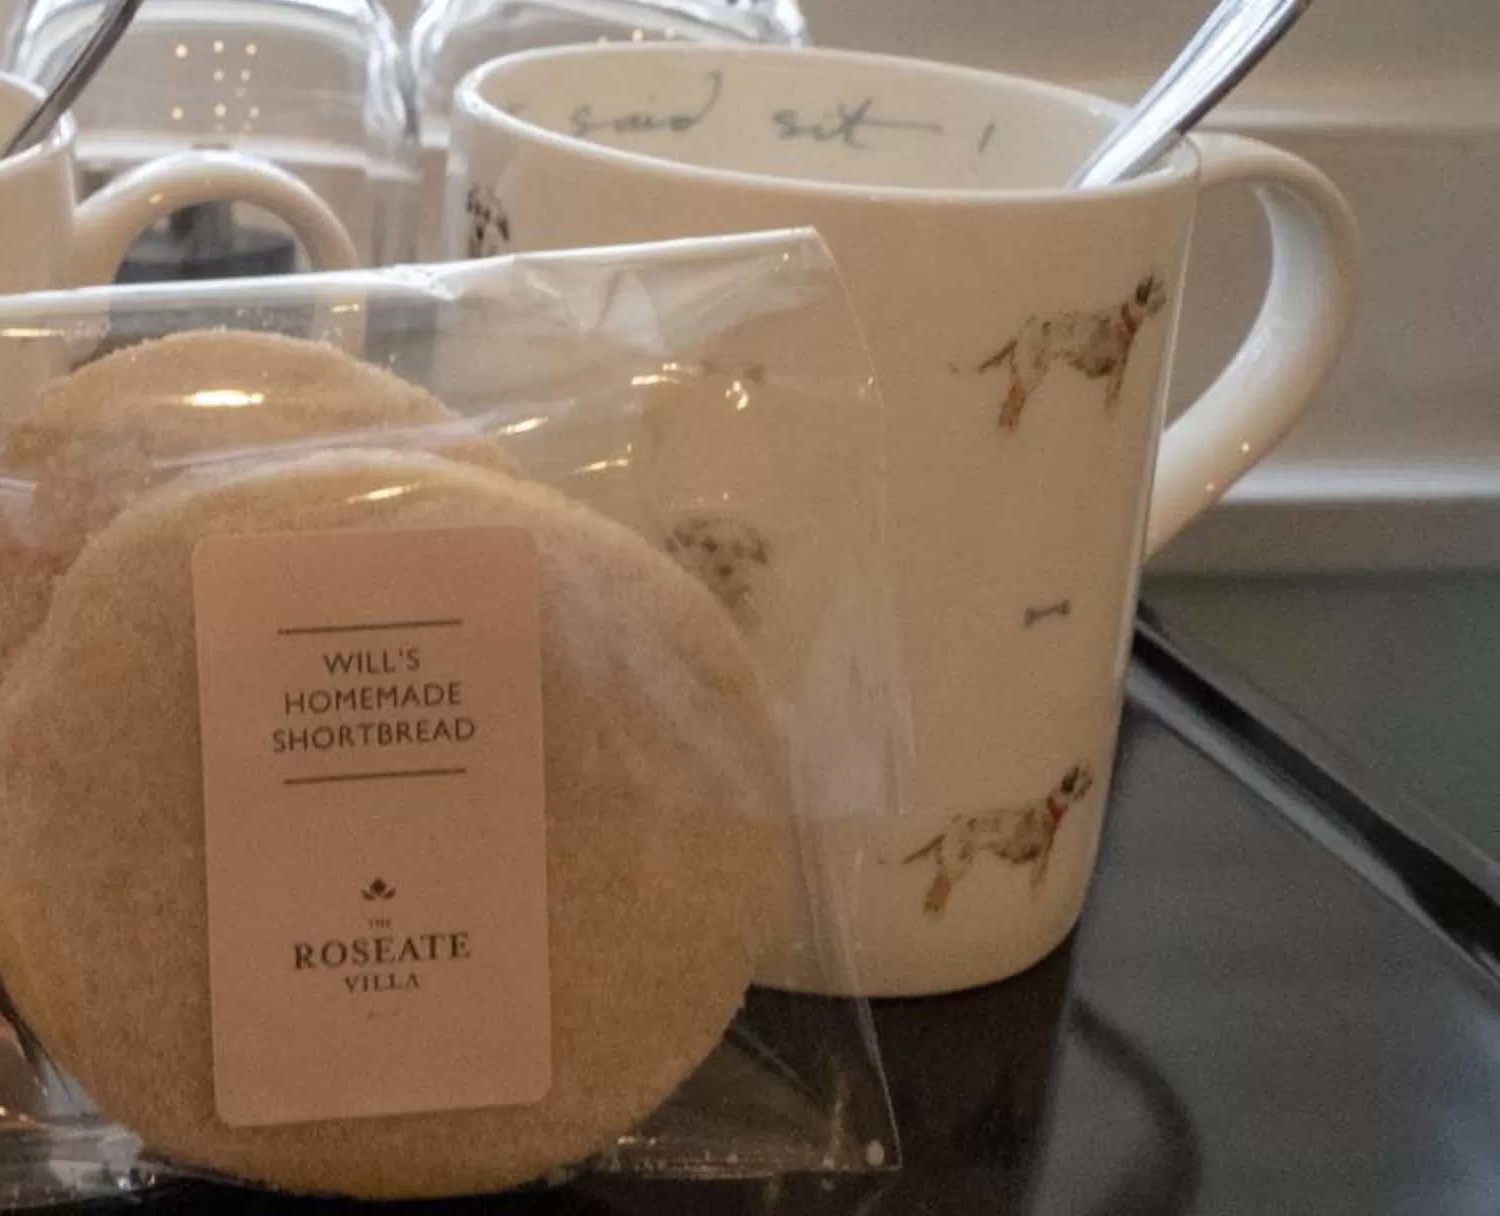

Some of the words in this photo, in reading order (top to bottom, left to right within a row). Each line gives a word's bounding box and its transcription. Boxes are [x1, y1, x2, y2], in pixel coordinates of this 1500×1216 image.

[571, 69, 724, 138] said
[323, 647, 421, 677] WILL'S
[285, 682, 462, 716] HOMEMADE
[272, 717, 476, 753] SHORTBREAD
[293, 931, 471, 971] ROSEATE
[343, 971, 421, 994] VILLA
